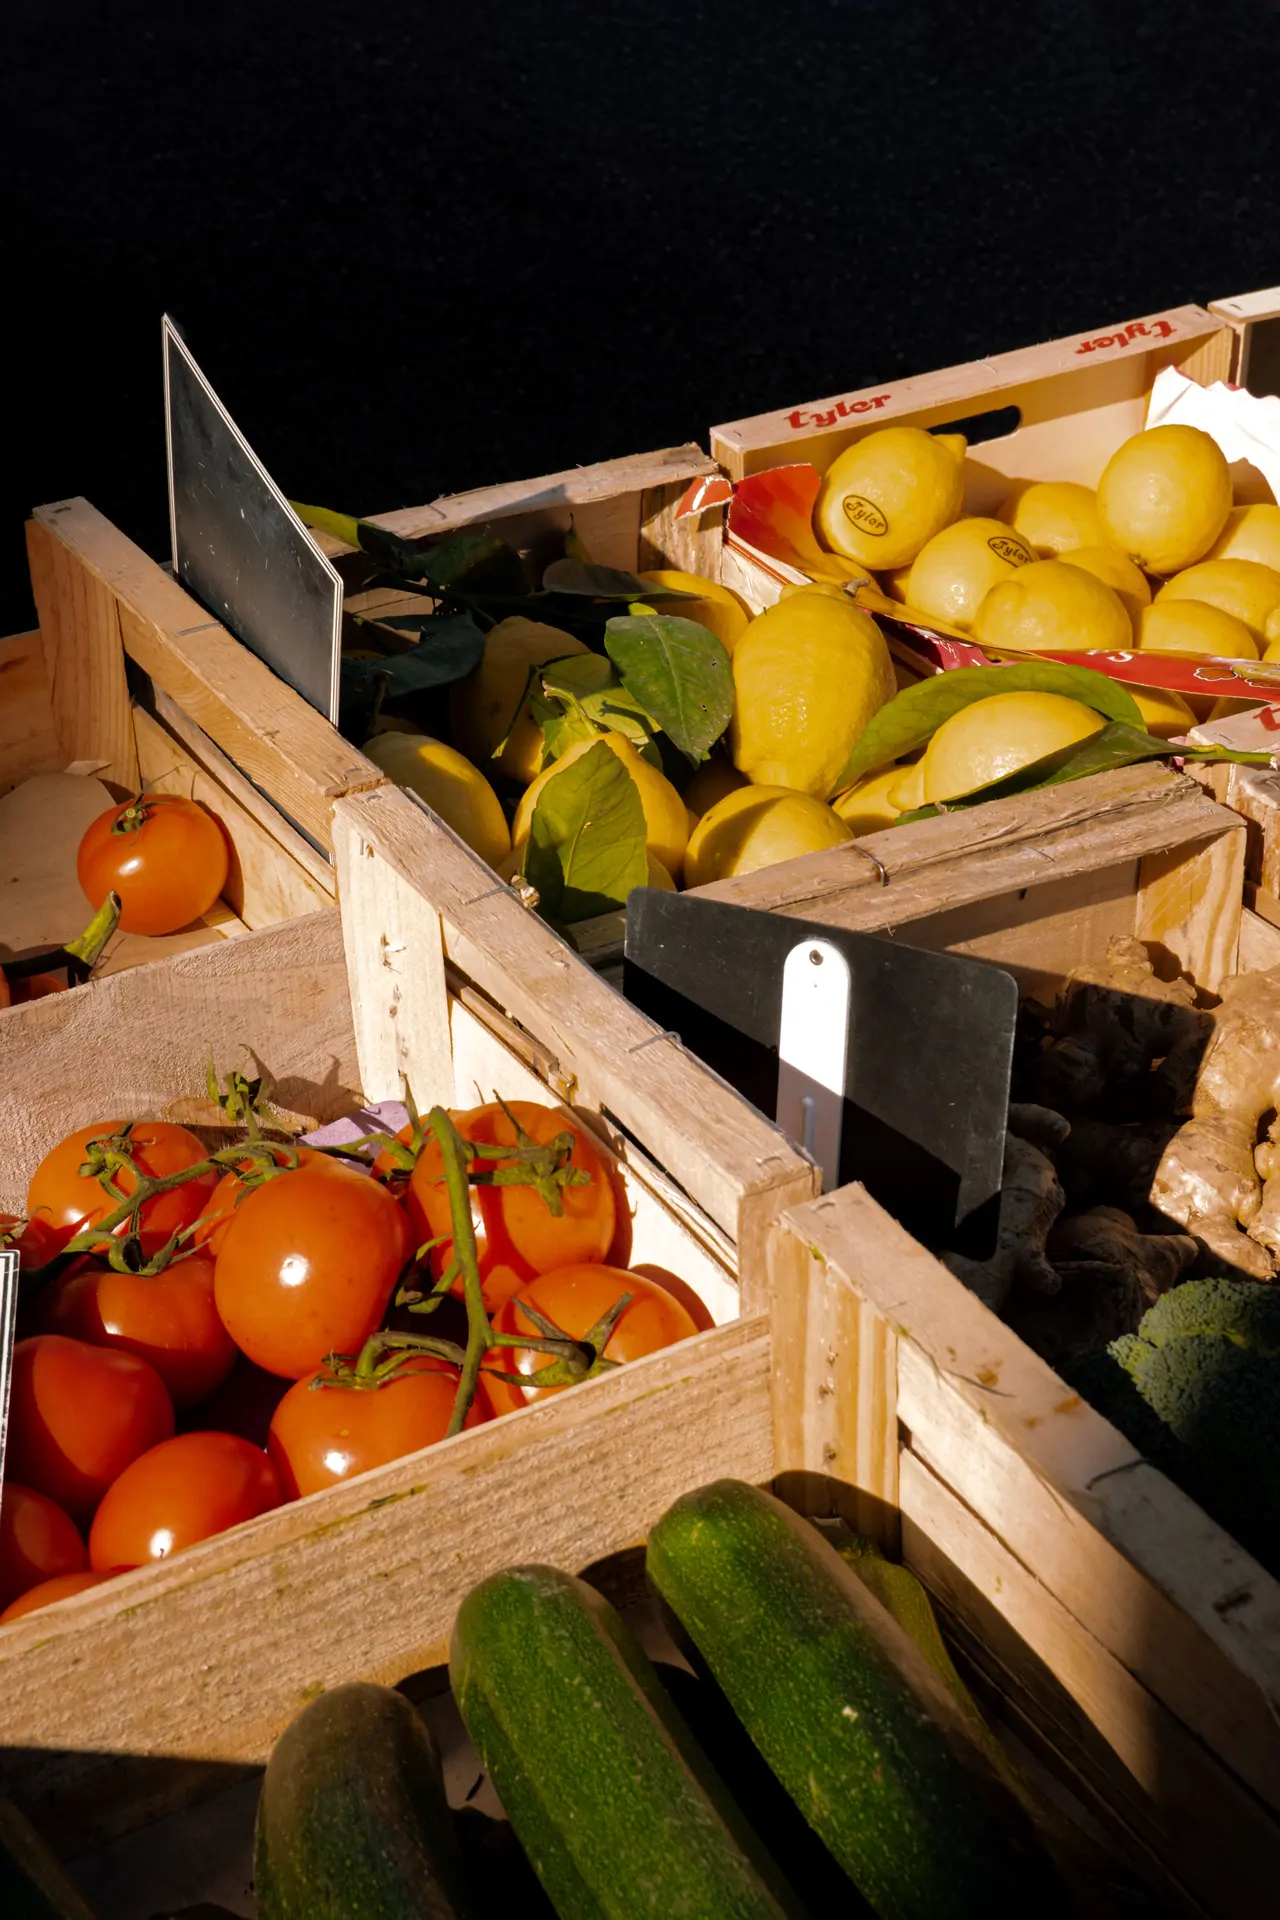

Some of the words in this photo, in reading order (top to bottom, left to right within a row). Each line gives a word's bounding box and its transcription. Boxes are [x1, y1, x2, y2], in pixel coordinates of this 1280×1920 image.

[1075, 320, 1178, 354] tyler
[784, 394, 892, 429] tyler
[845, 501, 885, 529] Tyler
